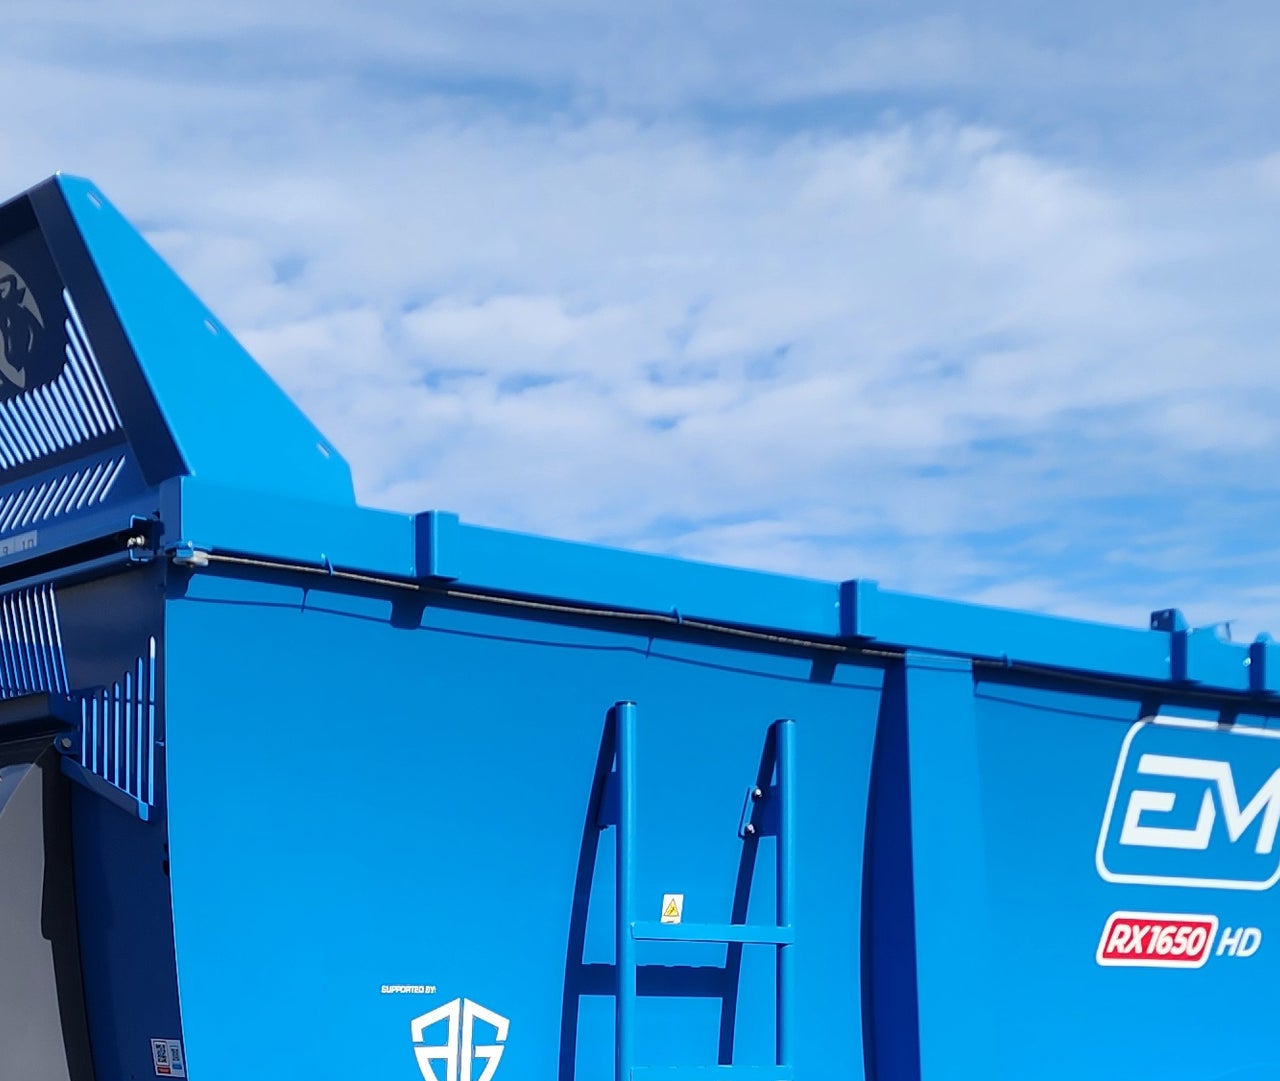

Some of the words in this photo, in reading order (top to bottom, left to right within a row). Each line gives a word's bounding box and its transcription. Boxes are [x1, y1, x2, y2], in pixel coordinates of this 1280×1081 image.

[1107, 923, 1208, 956] RX1650
[1215, 926, 1263, 958] HD
[381, 985, 425, 994] SUPPORTED
